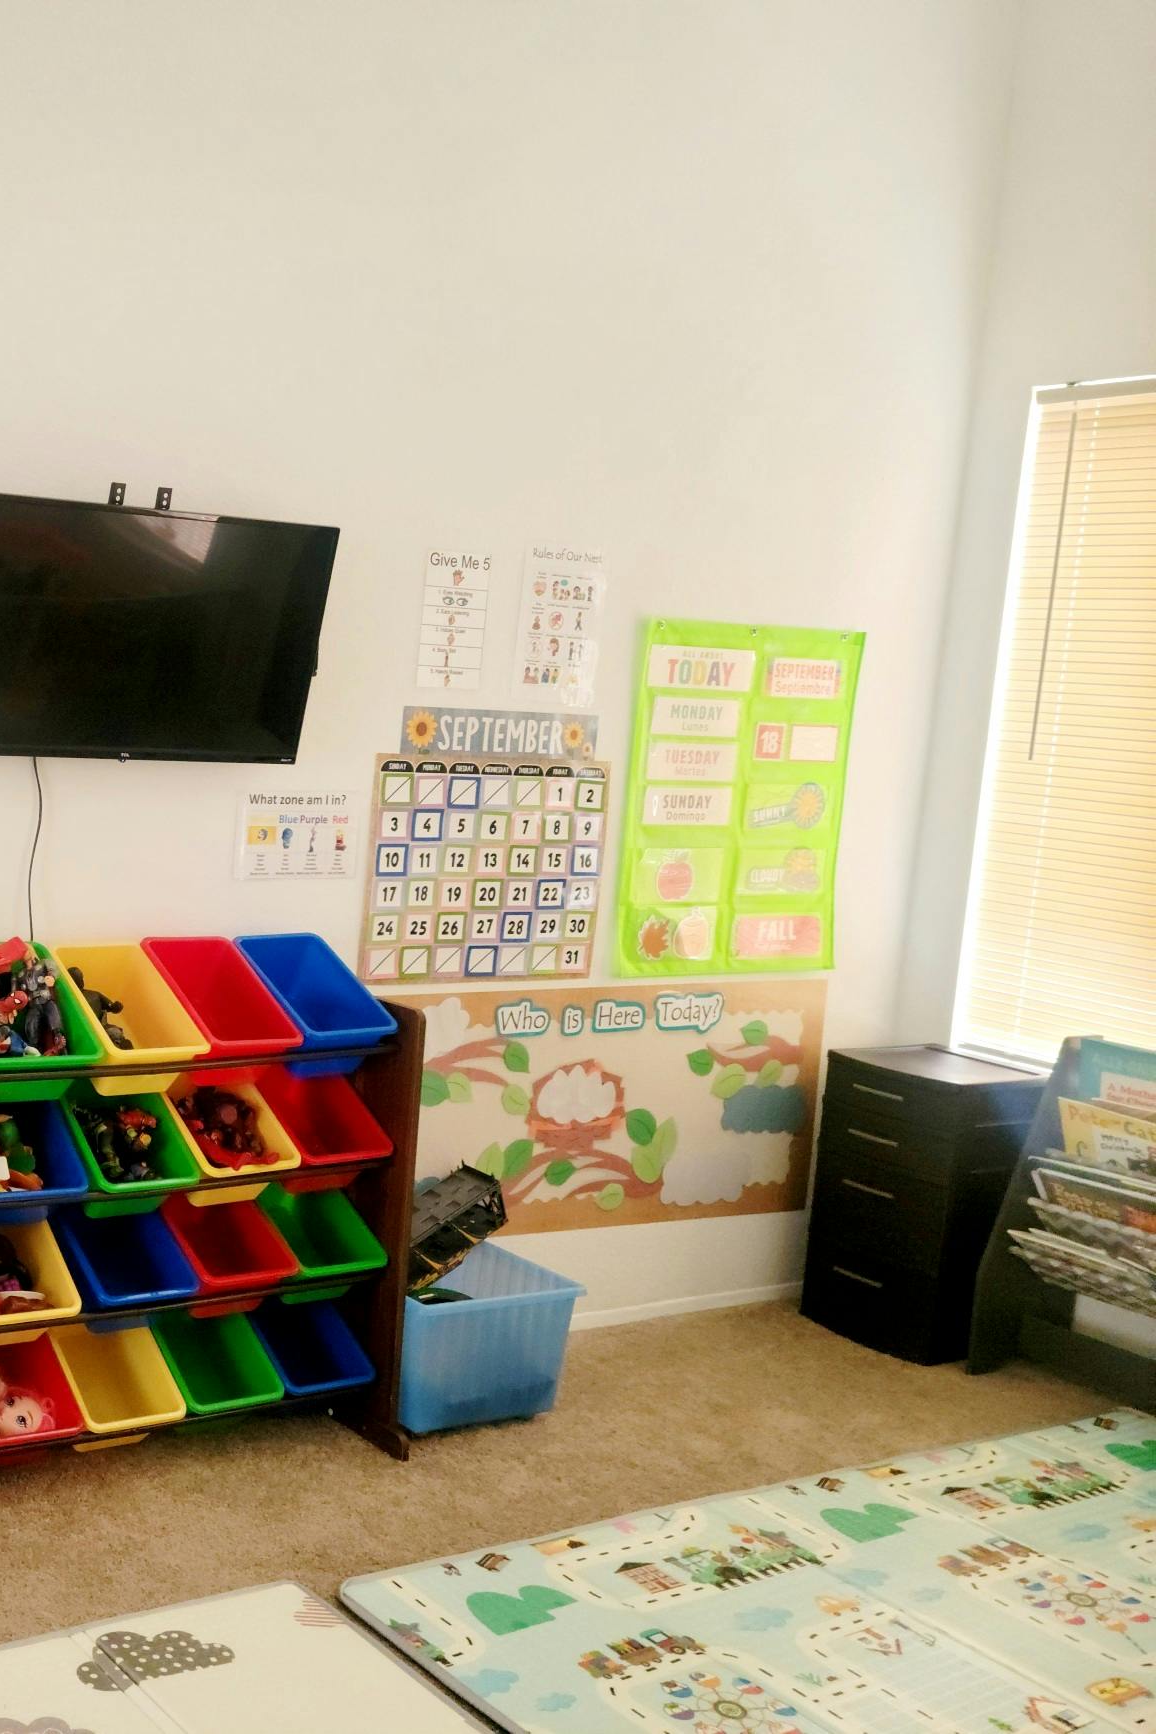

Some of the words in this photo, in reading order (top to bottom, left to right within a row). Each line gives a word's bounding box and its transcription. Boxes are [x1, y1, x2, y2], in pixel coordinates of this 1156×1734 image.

[430, 552, 458, 568] Give
[462, 555, 479, 569] Me
[483, 557, 490, 571] 5
[668, 659, 735, 687] TODAY
[774, 661, 835, 681] SEPTEMBER
[670, 704, 724, 721] MONDAY
[438, 715, 563, 754] SEPTEMBER
[682, 721, 709, 732] Lunes
[759, 730, 779, 755] 18
[665, 748, 720, 766] TUESDAY
[249, 793, 277, 805] What
[280, 796, 304, 805] zone
[307, 796, 322, 805] am
[325, 795, 329, 805] I
[331, 794, 347, 806] in?
[558, 788, 562, 801] 1
[587, 789, 594, 802] 2
[662, 794, 713, 809] SUNDAY
[279, 815, 298, 824] Blue
[300, 815, 328, 826] Purple
[332, 815, 348, 824] Red
[666, 810, 706, 823] Domingo
[391, 817, 397, 831] 3
[424, 818, 431, 832] 4
[458, 819, 465, 832] 5
[490, 820, 496, 834] 6
[523, 820, 529, 834] 7
[554, 821, 560, 835] 8
[585, 822, 591, 835] 9
[386, 853, 399, 867] 10
[420, 853, 430, 867] 11
[451, 853, 464, 867] 12
[484, 853, 497, 867] 13
[517, 854, 529, 867] 14
[548, 853, 561, 867] 15
[580, 855, 591, 868] 16
[383, 887, 396, 901] 17
[415, 886, 428, 901] 18
[448, 887, 461, 902] 19
[479, 887, 495, 901] 20
[513, 887, 526, 901] 21
[543, 888, 557, 900] 22
[575, 887, 588, 900] 23
[377, 921, 392, 935] 24
[410, 921, 426, 935] 25
[442, 921, 458, 935] 26
[477, 919, 493, 933] 27
[508, 920, 523, 933] 28
[540, 920, 555, 933] 29
[570, 919, 585, 933] 30
[757, 919, 796, 941] FALL
[566, 951, 578, 963] 31
[500, 1002, 546, 1031] Who
[567, 1008, 579, 1030] is
[597, 1005, 640, 1027] Here
